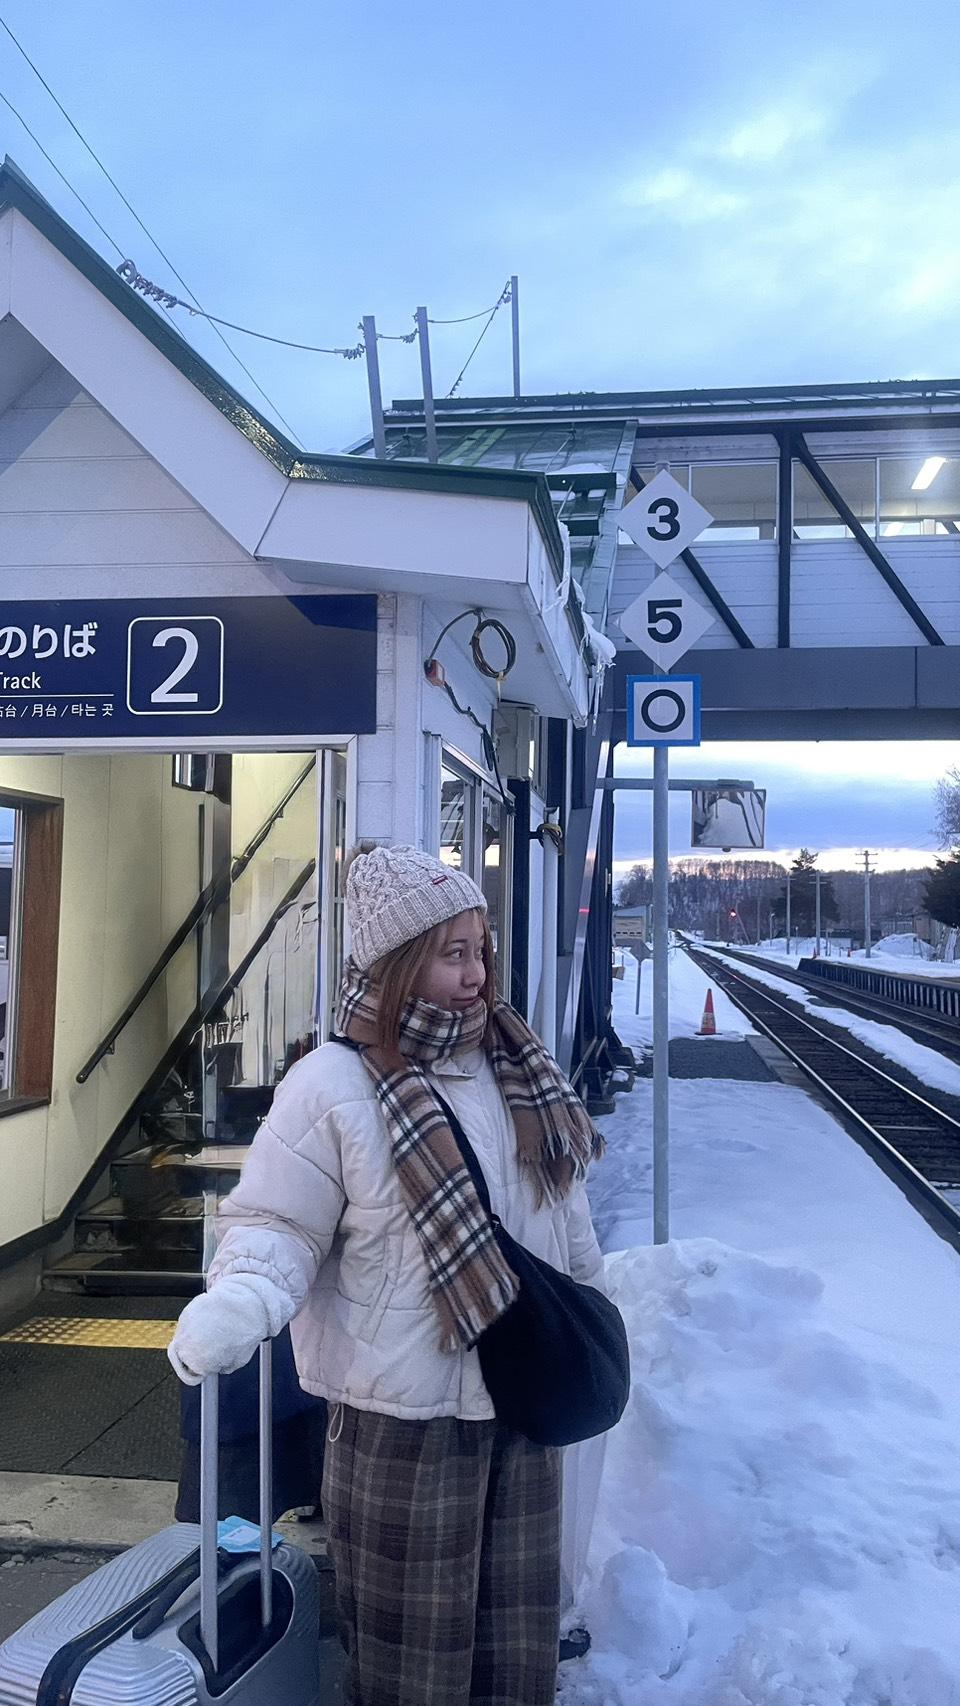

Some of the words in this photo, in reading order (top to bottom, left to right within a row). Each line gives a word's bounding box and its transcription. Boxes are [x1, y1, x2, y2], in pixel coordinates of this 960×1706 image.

[647, 498, 681, 541] 3
[0, 622, 98, 658] のりば
[647, 599, 682, 644] 5
[151, 628, 199, 702] 2
